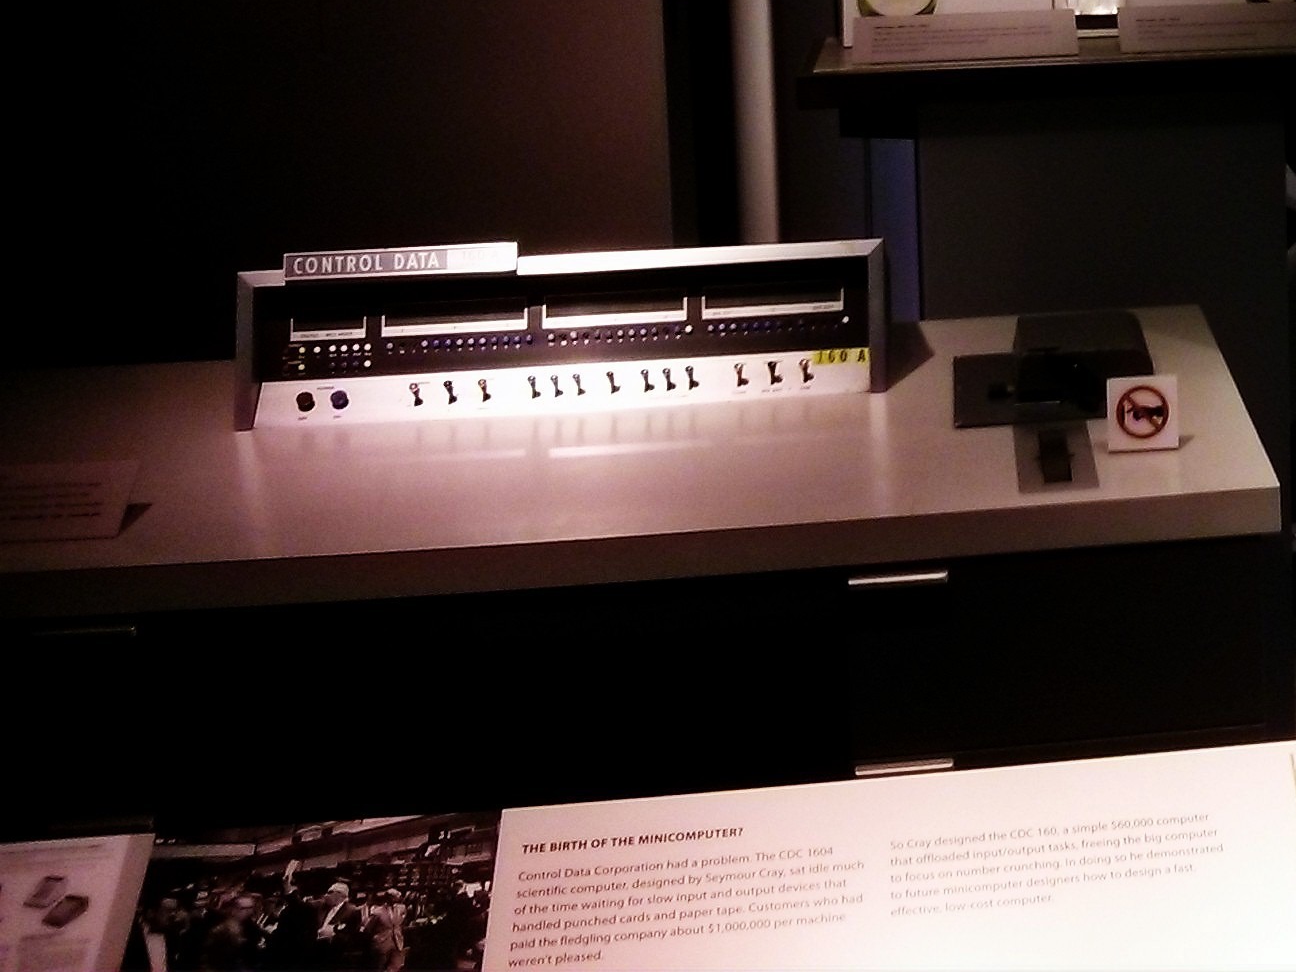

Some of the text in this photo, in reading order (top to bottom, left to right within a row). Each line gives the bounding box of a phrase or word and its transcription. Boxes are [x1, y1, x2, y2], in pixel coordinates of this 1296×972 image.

[293, 254, 383, 275] CONTROL
[394, 252, 440, 270] DATA
[857, 349, 867, 362] A
[521, 828, 744, 855] THE BIRTH OF THE MINICOMPUTER?
[515, 884, 568, 900] scientific
[630, 874, 686, 890] designed
[687, 873, 703, 887] by
[704, 870, 757, 885] Seymour
[789, 865, 806, 876] sat
[808, 862, 829, 875] idle
[832, 859, 865, 872] much
[517, 867, 563, 883] Control
[563, 867, 592, 879] Data
[593, 861, 665, 878] Corporation
[665, 857, 690, 870] had
[690, 859, 699, 869] a
[755, 851, 777, 862] The
[778, 849, 804, 860] CDC
[808, 846, 834, 858] 1604
[511, 917, 562, 934] handled
[562, 913, 618, 932] punched
[618, 910, 652, 925] cards
[652, 908, 677, 922] and
[678, 908, 714, 922] paper
[747, 900, 811, 913] Customers
[813, 896, 839, 907] who
[841, 892, 864, 905] had
[513, 878, 847, 917] of the time waiting for slow input and output devices that
[509, 936, 537, 953] paid
[537, 935, 559, 949] the
[559, 932, 612, 948] fledgling
[612, 928, 669, 943] company
[669, 924, 705, 938] about
[773, 918, 793, 930] per
[795, 913, 846, 926] machine
